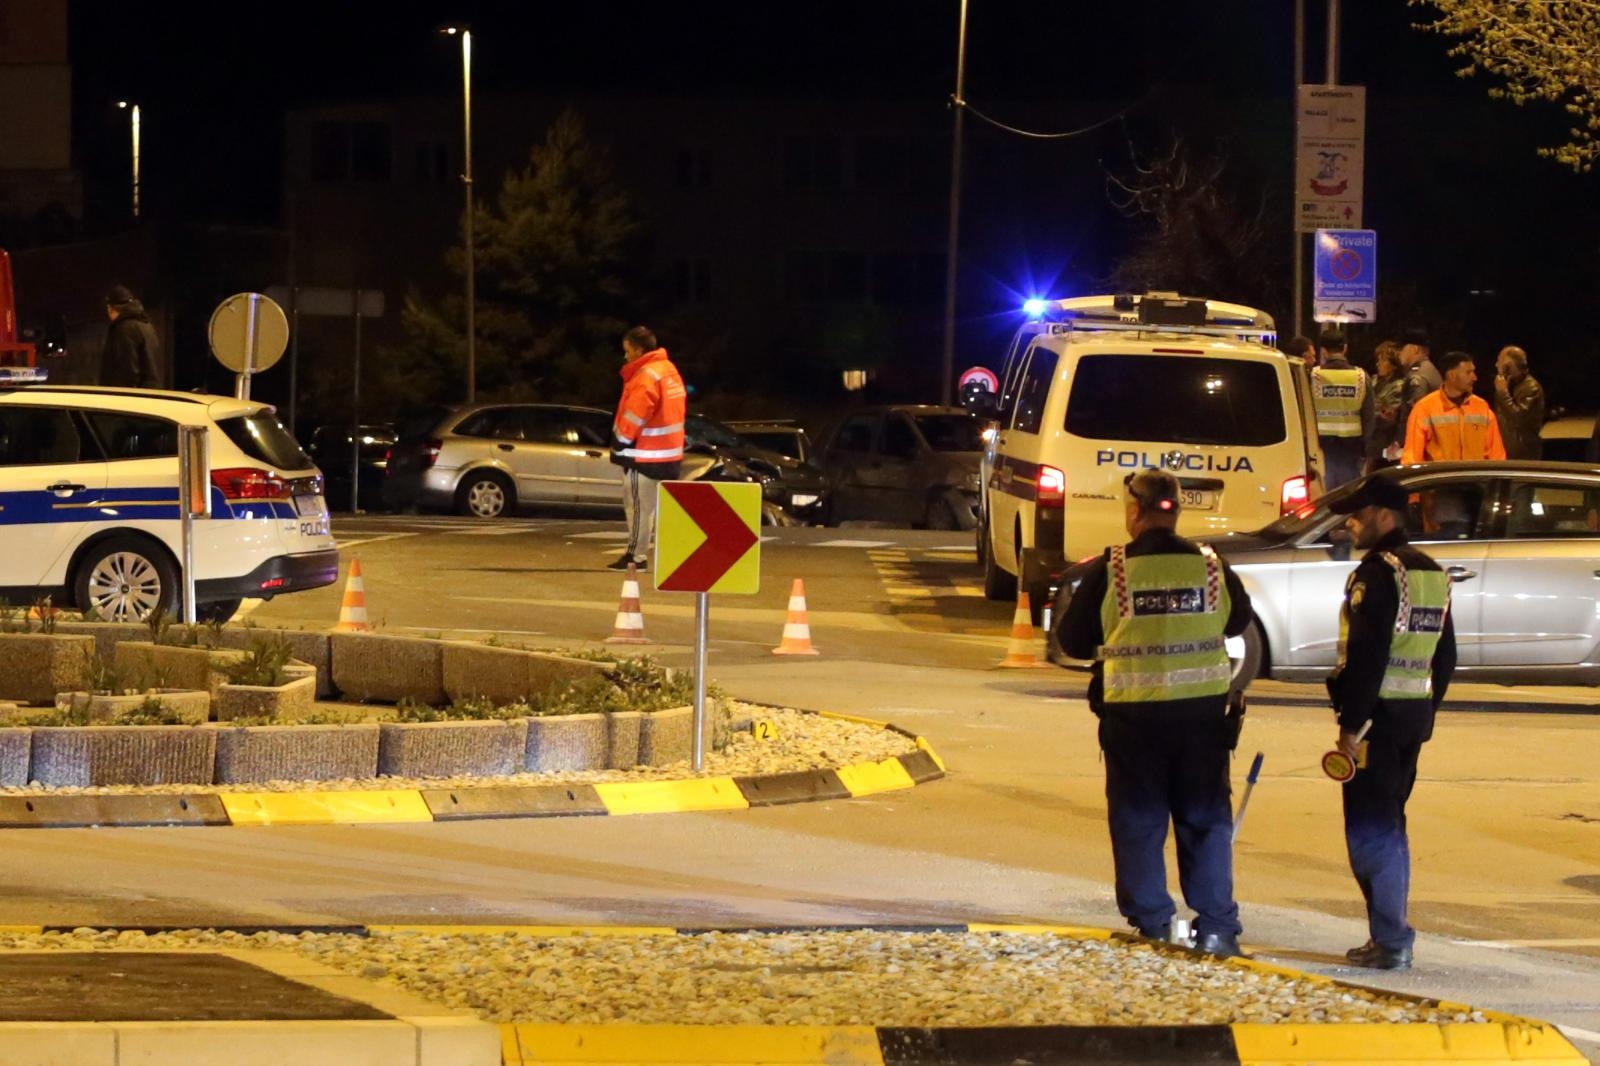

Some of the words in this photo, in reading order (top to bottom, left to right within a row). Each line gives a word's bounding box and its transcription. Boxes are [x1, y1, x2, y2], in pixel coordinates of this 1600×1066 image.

[1096, 450, 1254, 473] POLICIJA
[1147, 643, 1195, 656] POLICIJA
[759, 722, 770, 739] 2
